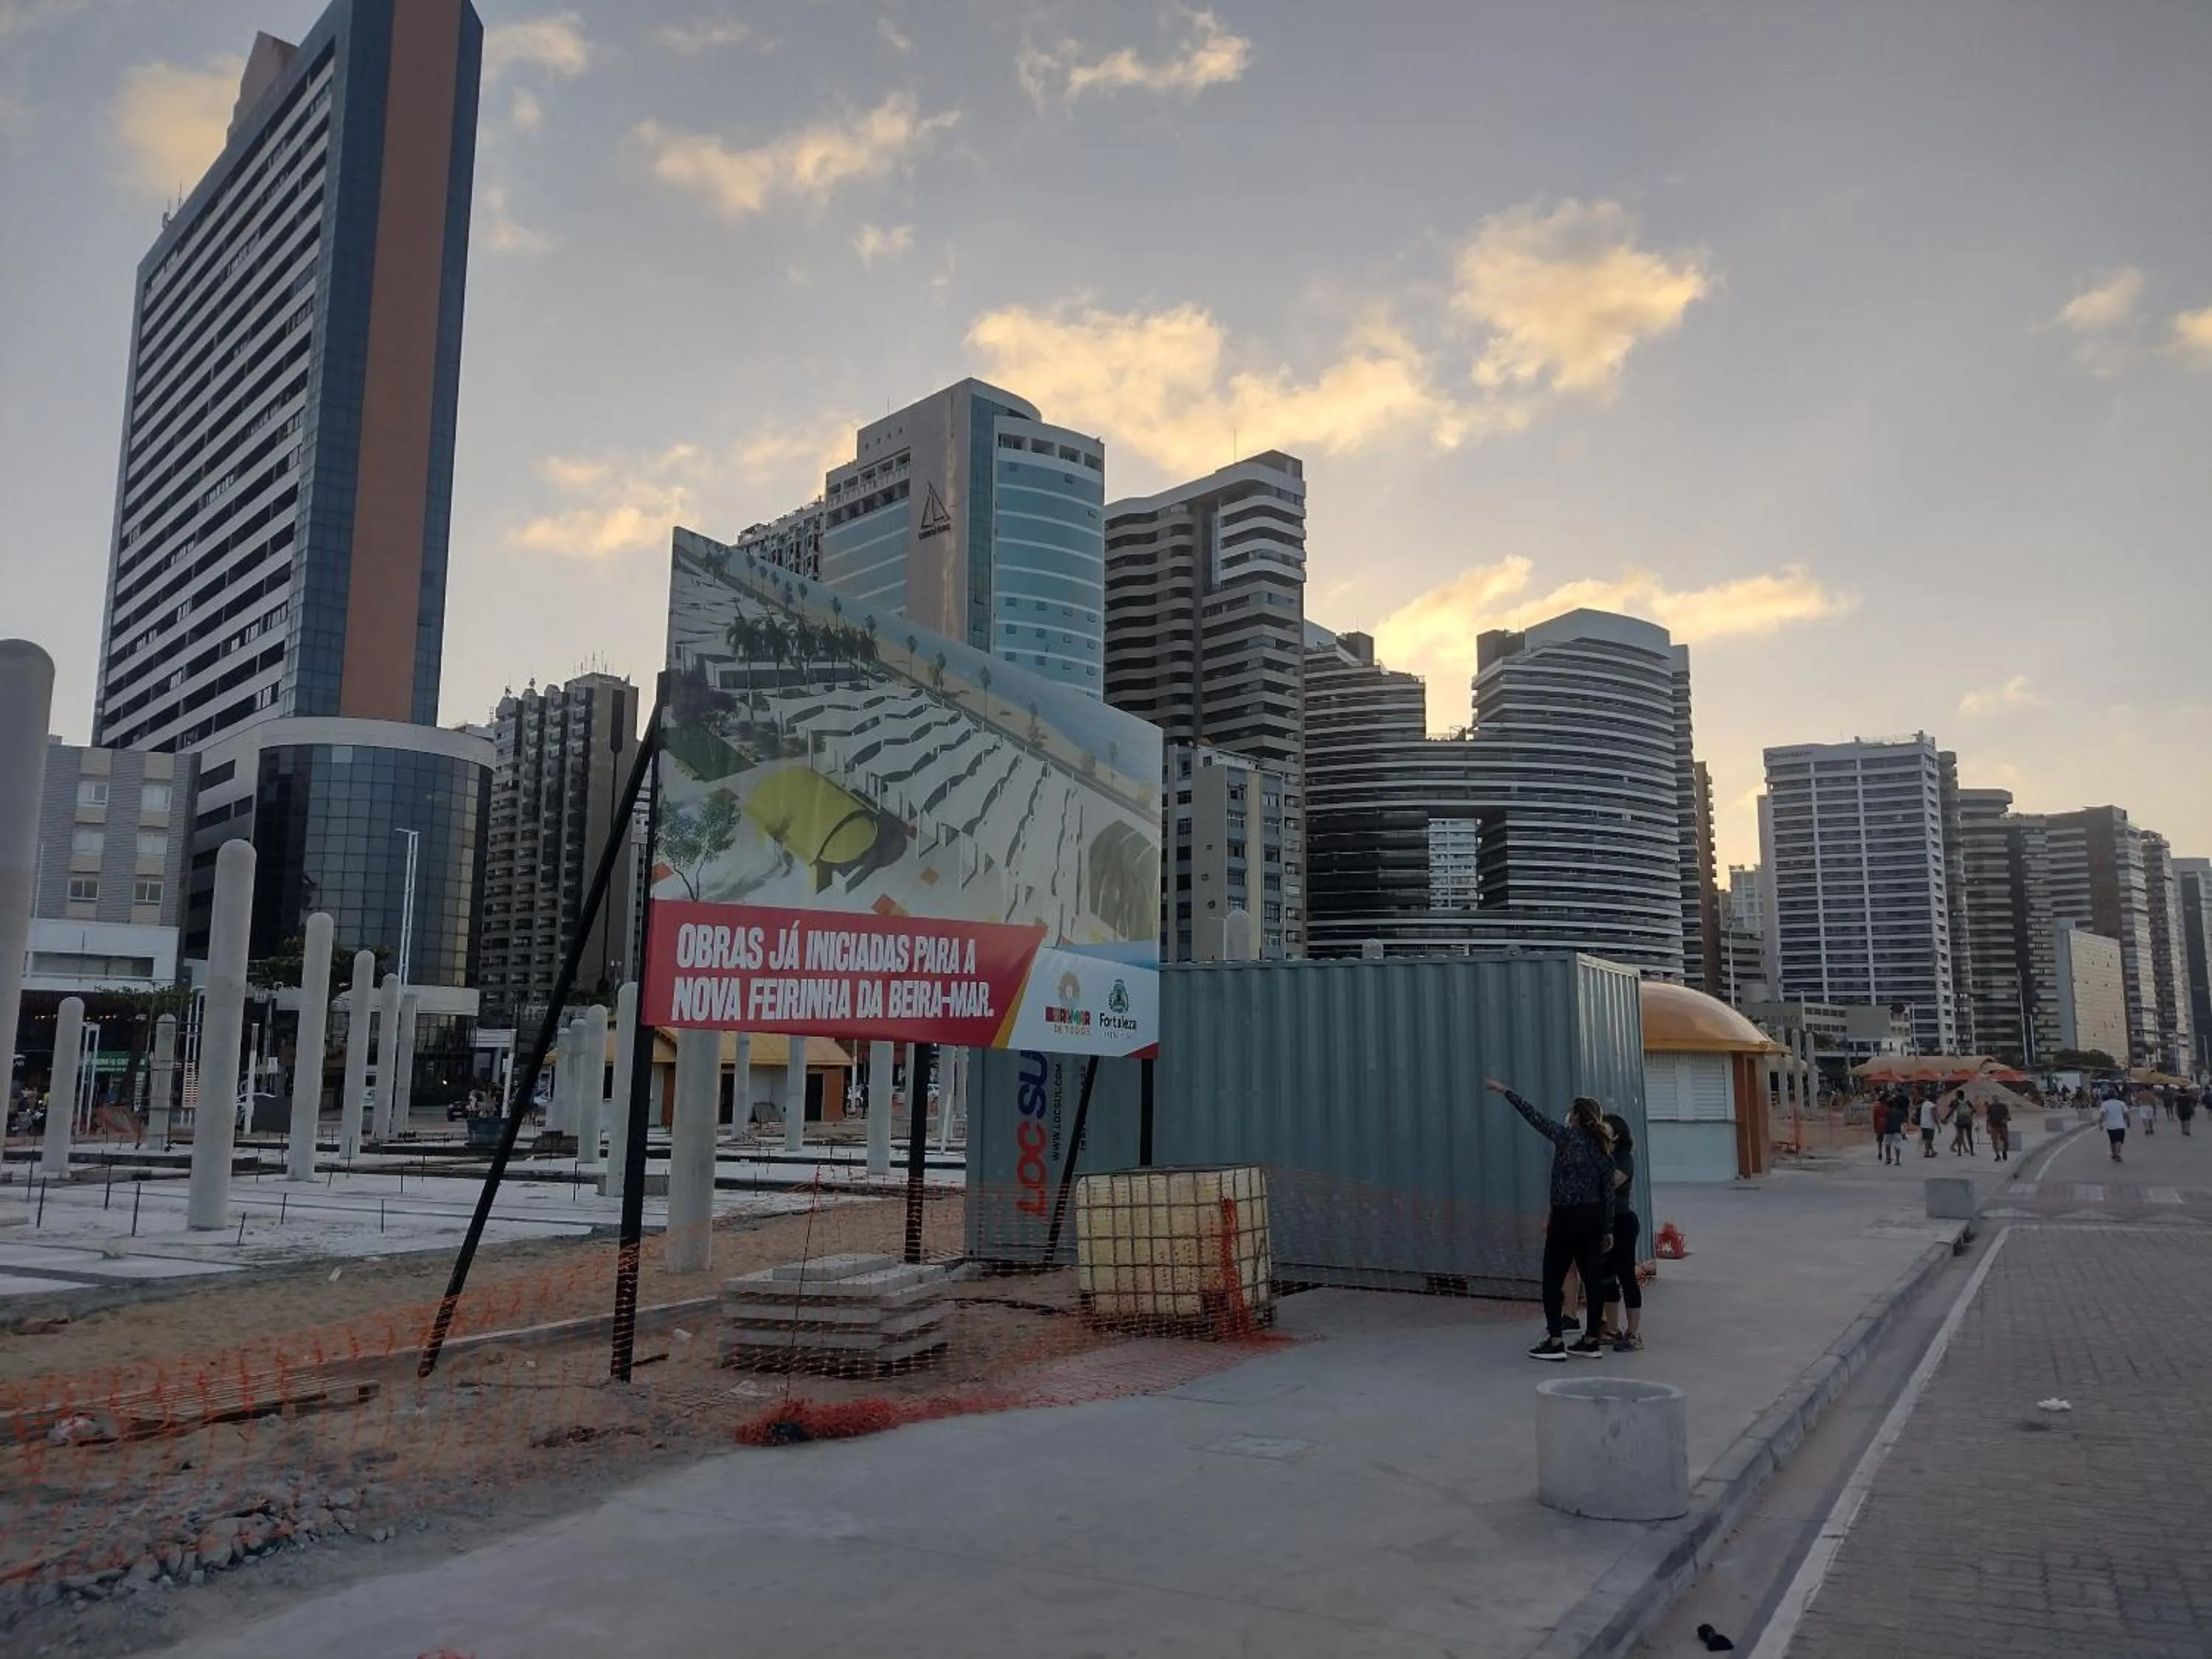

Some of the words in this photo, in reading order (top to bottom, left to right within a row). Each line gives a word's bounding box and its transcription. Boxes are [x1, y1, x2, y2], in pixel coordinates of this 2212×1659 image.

[677, 923, 764, 969] OBRAS
[769, 920, 800, 969] JÁ
[805, 931, 910, 972] INICIADAS
[913, 936, 959, 973] PARA
[964, 939, 975, 973] A
[672, 976, 741, 1021] NOVA
[748, 978, 851, 1020] FEIRINHA
[857, 979, 883, 1018] DA
[888, 980, 994, 1018] BEIRA-MAR.
[1099, 1012, 1136, 1030] Fortaleza
